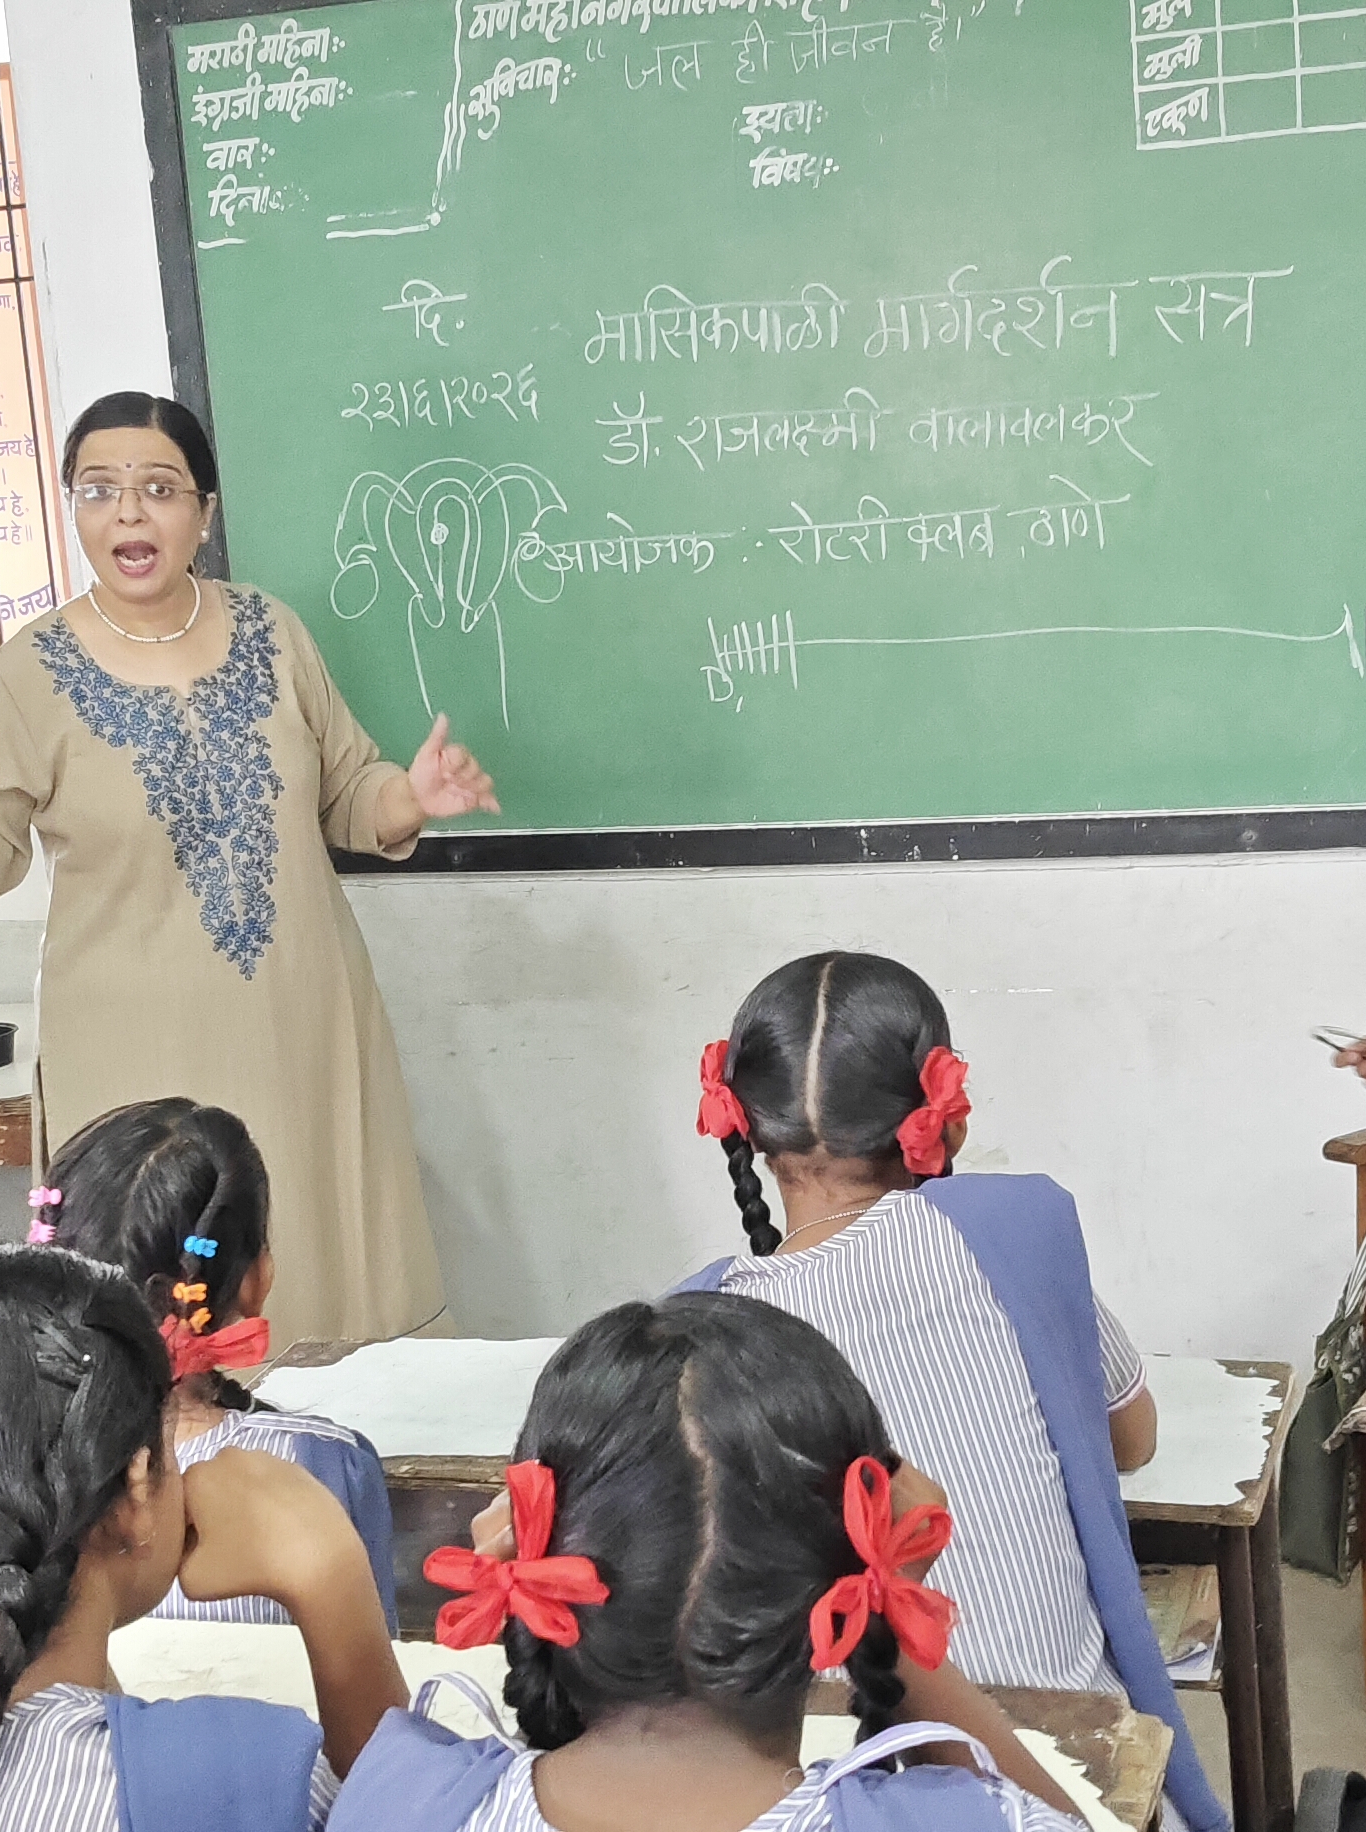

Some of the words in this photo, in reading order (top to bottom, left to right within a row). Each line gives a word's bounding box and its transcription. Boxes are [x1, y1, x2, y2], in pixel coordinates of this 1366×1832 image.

[187, 23, 256, 73] मराठी
[785, 15, 917, 73] जीवन
[1143, 33, 1202, 81] मुली
[584, 284, 849, 364] मासिकपाळी
[864, 256, 1139, 358] मार्गदर्शन
[1149, 265, 1295, 348] सत्र
[767, 494, 903, 567] रोटरी
